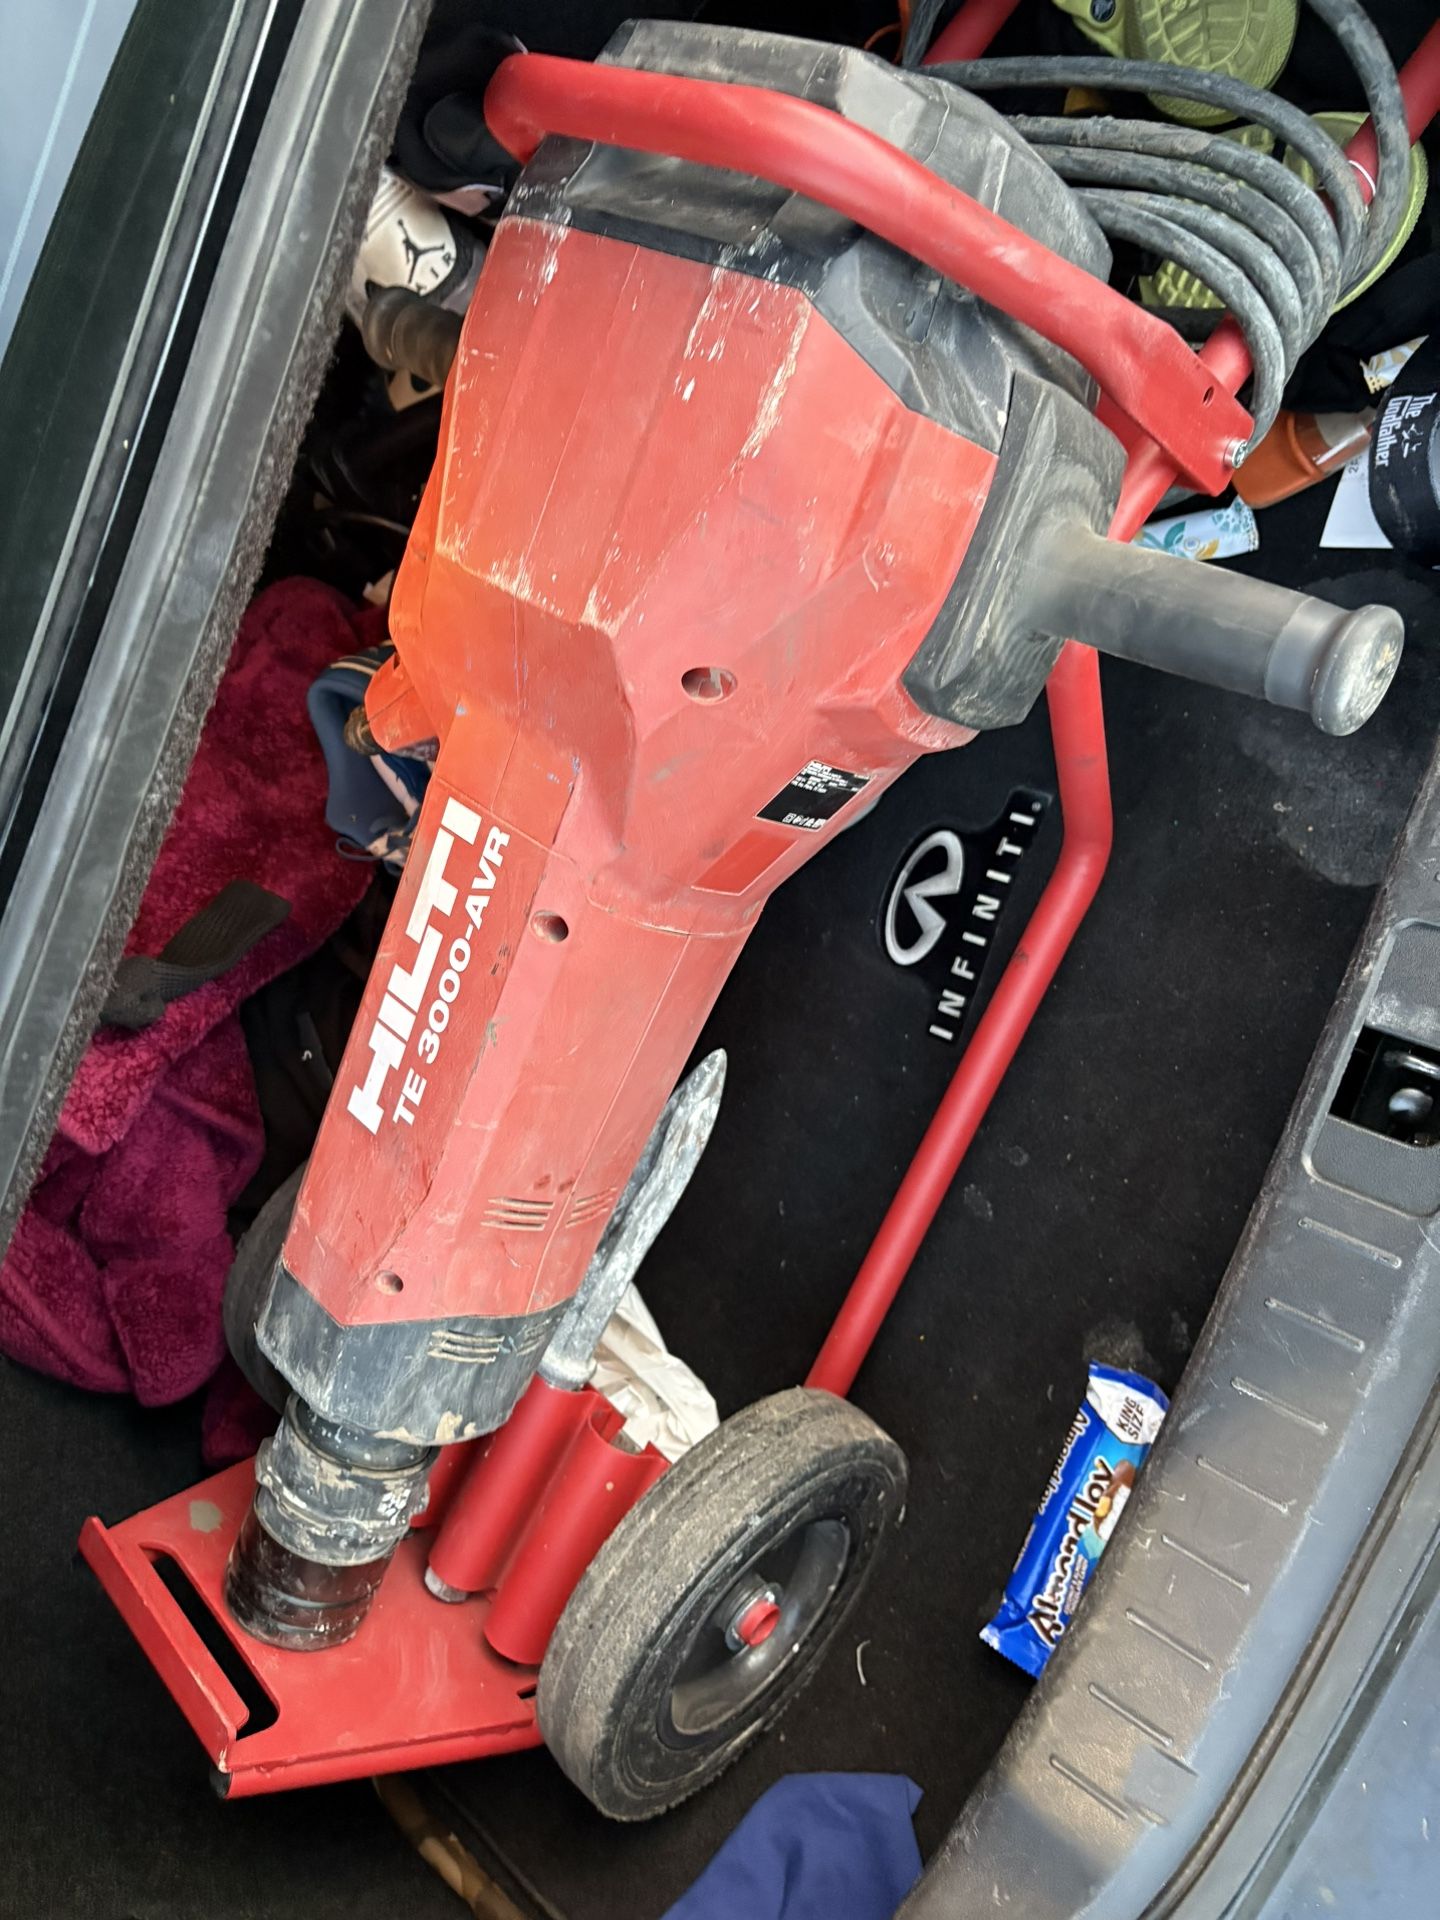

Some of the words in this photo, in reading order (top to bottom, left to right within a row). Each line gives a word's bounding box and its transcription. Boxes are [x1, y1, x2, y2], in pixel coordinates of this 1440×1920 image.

[1376, 395, 1412, 467] Godfather
[1404, 392, 1437, 419] The
[346, 796, 483, 1135] HILTI
[392, 1067, 428, 1127] TE
[417, 825, 511, 1065] 3000-AVR
[928, 811, 1036, 1041] INFINITI
[1116, 1396, 1138, 1432] KING
[1027, 1507, 1093, 1649] Almond
